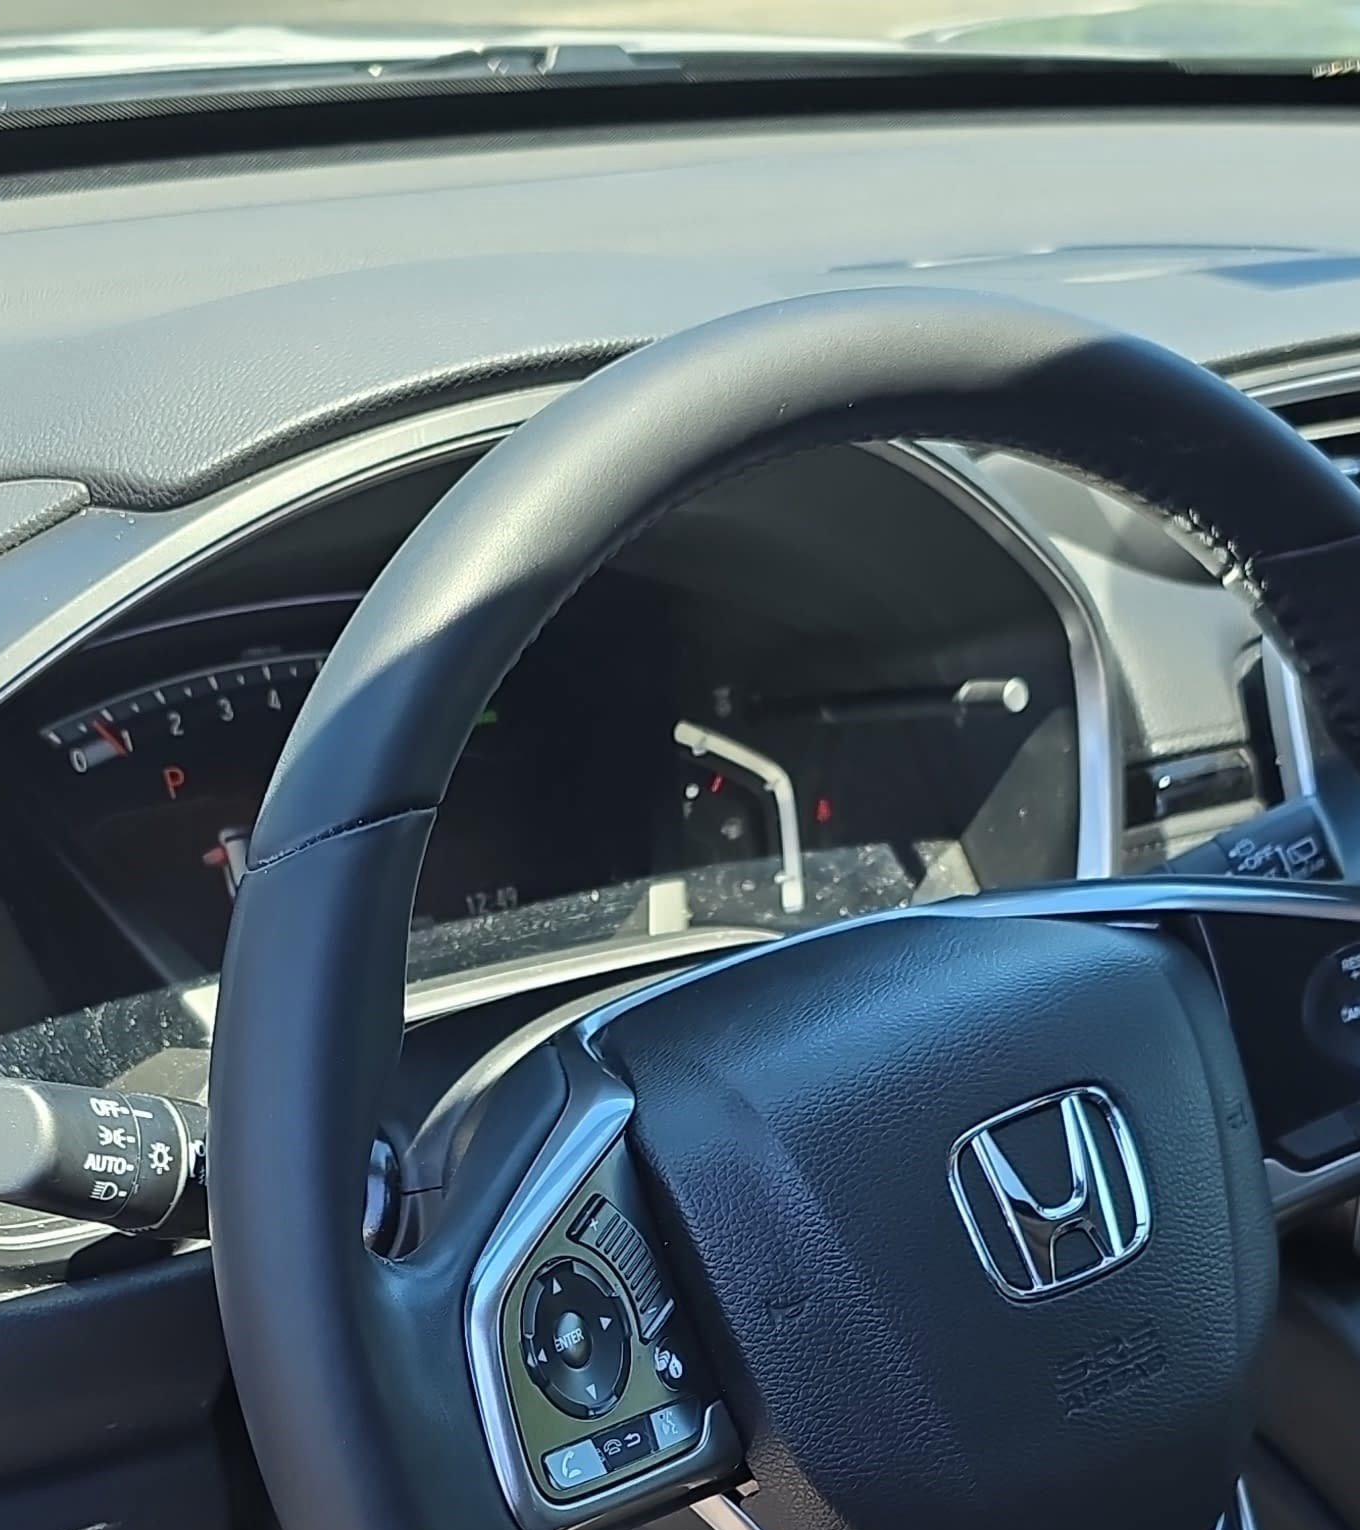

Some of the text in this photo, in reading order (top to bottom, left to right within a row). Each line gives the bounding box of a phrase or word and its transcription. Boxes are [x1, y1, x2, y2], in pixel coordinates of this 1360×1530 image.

[70, 688, 282, 773] 0 1 2 3 4
[163, 765, 185, 800] P
[90, 1098, 121, 1118] OFF
[83, 1152, 128, 1176] AUTO
[554, 1328, 585, 1353] ENTER
